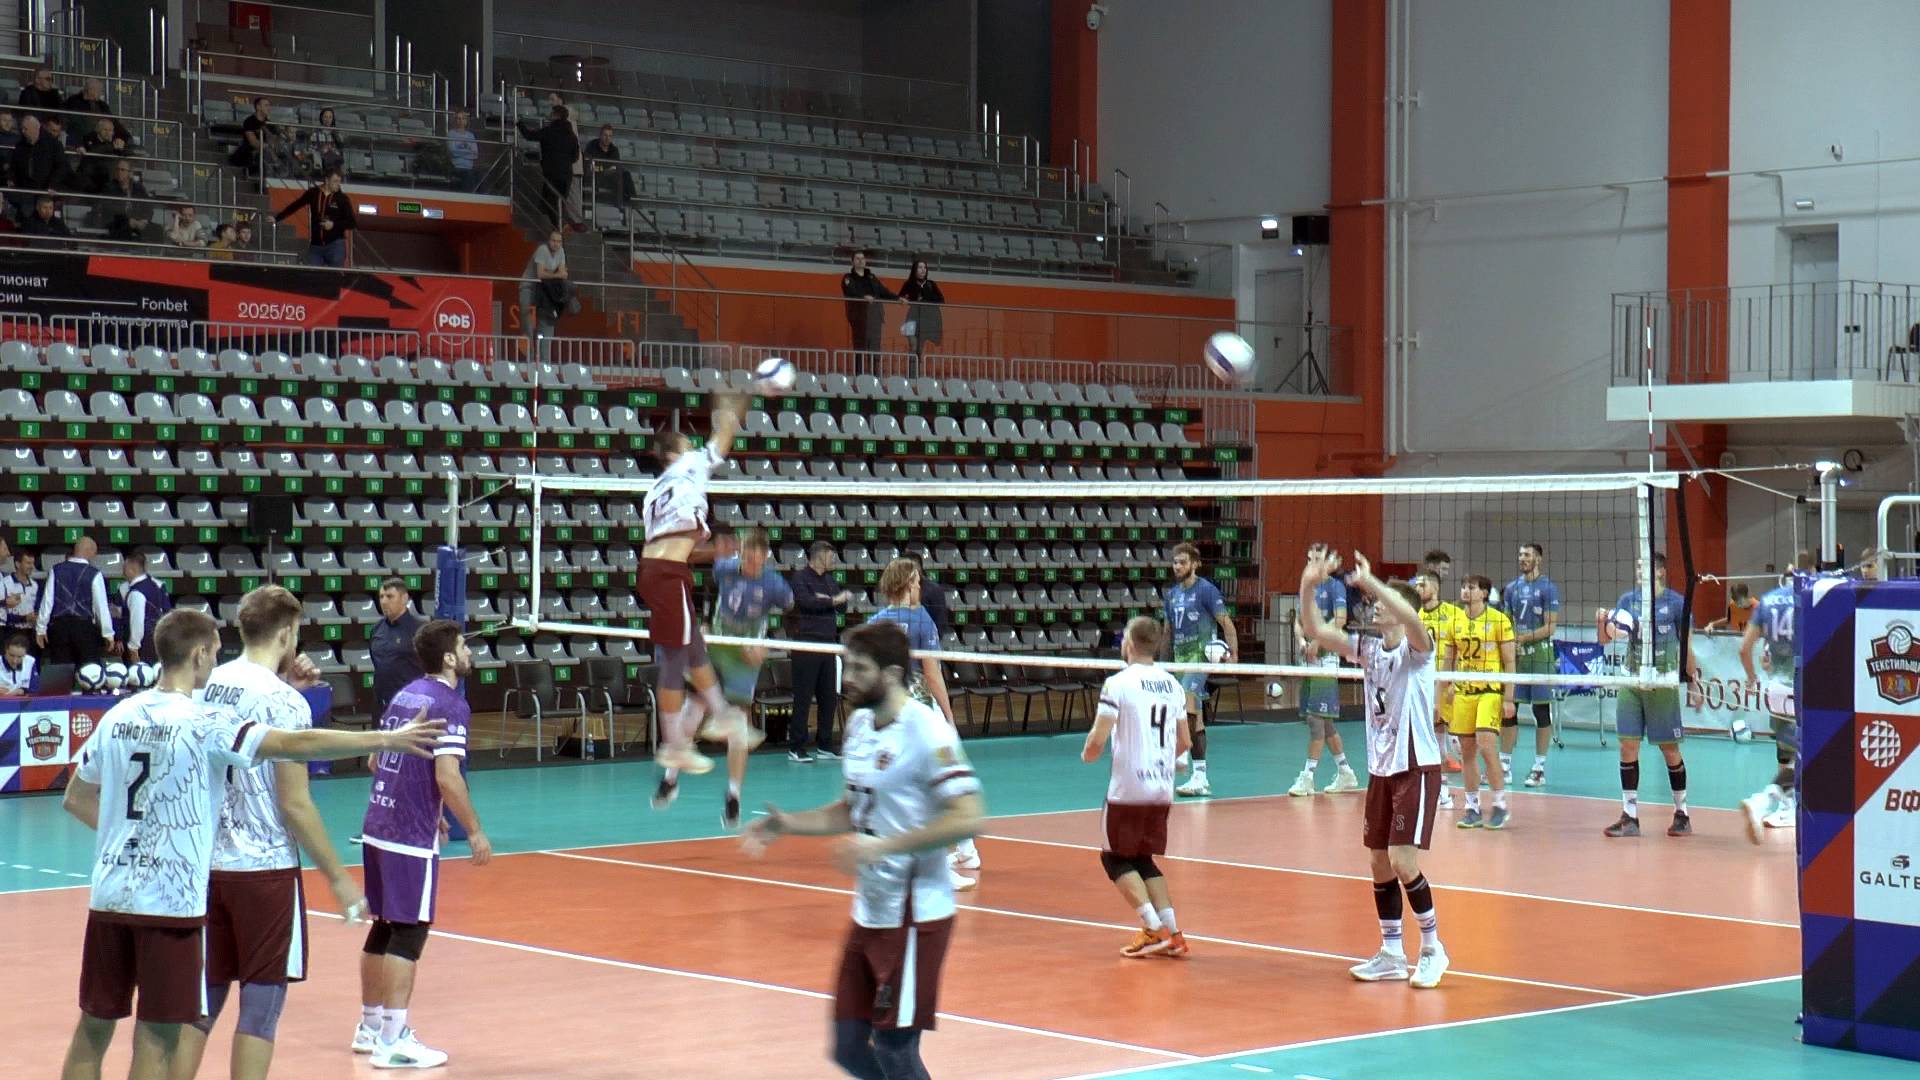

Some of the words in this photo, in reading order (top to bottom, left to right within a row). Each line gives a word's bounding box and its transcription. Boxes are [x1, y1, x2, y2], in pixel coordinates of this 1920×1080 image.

[142, 297, 188, 312] Fonbet
[238, 302, 306, 321] 2025/26
[438, 313, 471, 329] РФБ
[1174, 606, 1185, 630] 17
[1519, 600, 1528, 620] 7
[1461, 637, 1481, 659] 22
[1150, 703, 1168, 748] 4
[126, 752, 152, 821] 2
